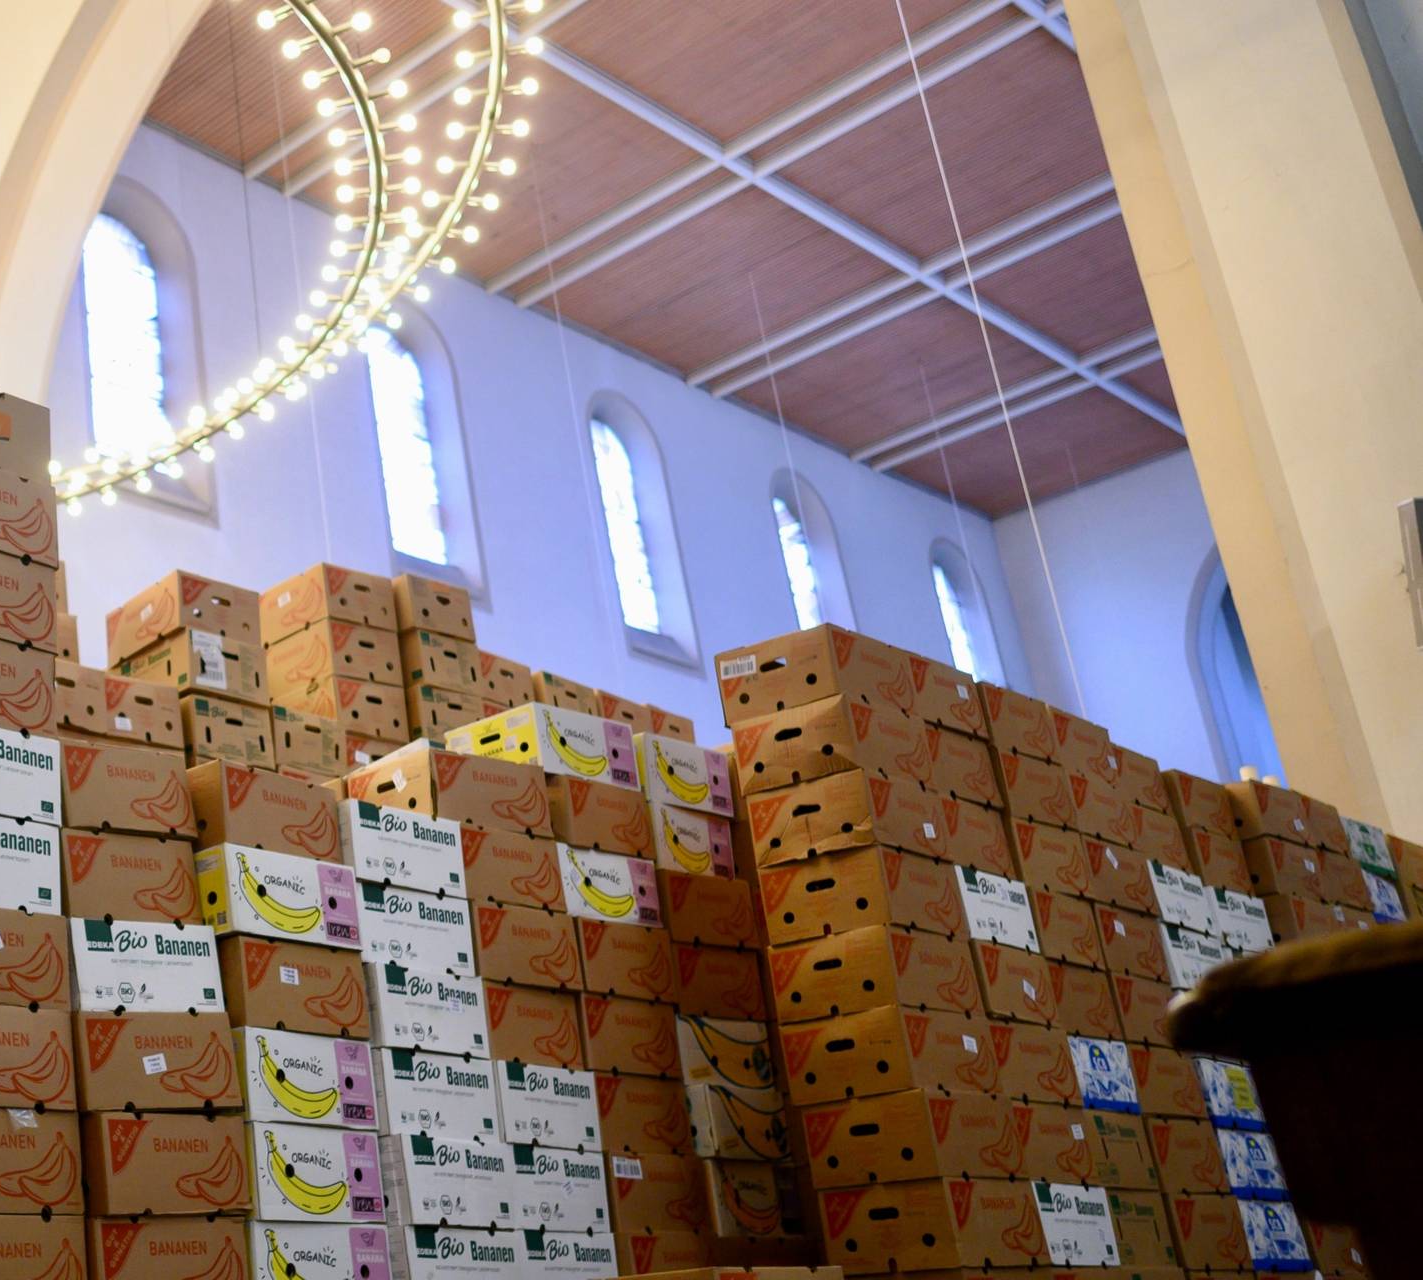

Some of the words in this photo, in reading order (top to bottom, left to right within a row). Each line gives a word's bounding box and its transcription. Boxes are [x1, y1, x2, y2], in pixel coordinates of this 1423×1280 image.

[564, 728, 596, 746] ORGANIC
[107, 765, 155, 782] BANANEN
[262, 789, 307, 811] BANANEN
[382, 813, 407, 833] Bio
[412, 821, 456, 847] Bananen
[110, 854, 162, 872] BANANEN
[264, 874, 306, 896] ORGANIC
[589, 868, 621, 885] ORGANIC
[385, 895, 413, 914] Bio
[418, 901, 464, 925] Bananen
[114, 929, 148, 953] Bio
[154, 934, 211, 957] Bananen
[407, 976, 433, 996] Bio
[134, 1035, 193, 1050] BANANEN
[283, 1057, 324, 1077] ORGANIC
[415, 1060, 441, 1082] Bio
[446, 1065, 489, 1090] Bananen
[526, 1072, 549, 1092] Bio
[553, 1077, 590, 1100] Bananen
[153, 1137, 209, 1153] BANANEN
[291, 1152, 333, 1171] ORGANIC
[436, 1144, 461, 1167] Bio
[465, 1149, 505, 1173] Bananen
[536, 1154, 559, 1175] Bio
[563, 1159, 600, 1180] Bananen
[1053, 1192, 1072, 1213] Bio
[149, 1241, 208, 1256] BANANEN
[293, 1250, 337, 1268] ORGANIC
[437, 1236, 465, 1260] Bio
[470, 1240, 515, 1263] Bananen
[546, 1239, 569, 1260] Bio
[573, 1242, 612, 1263] Bananen
